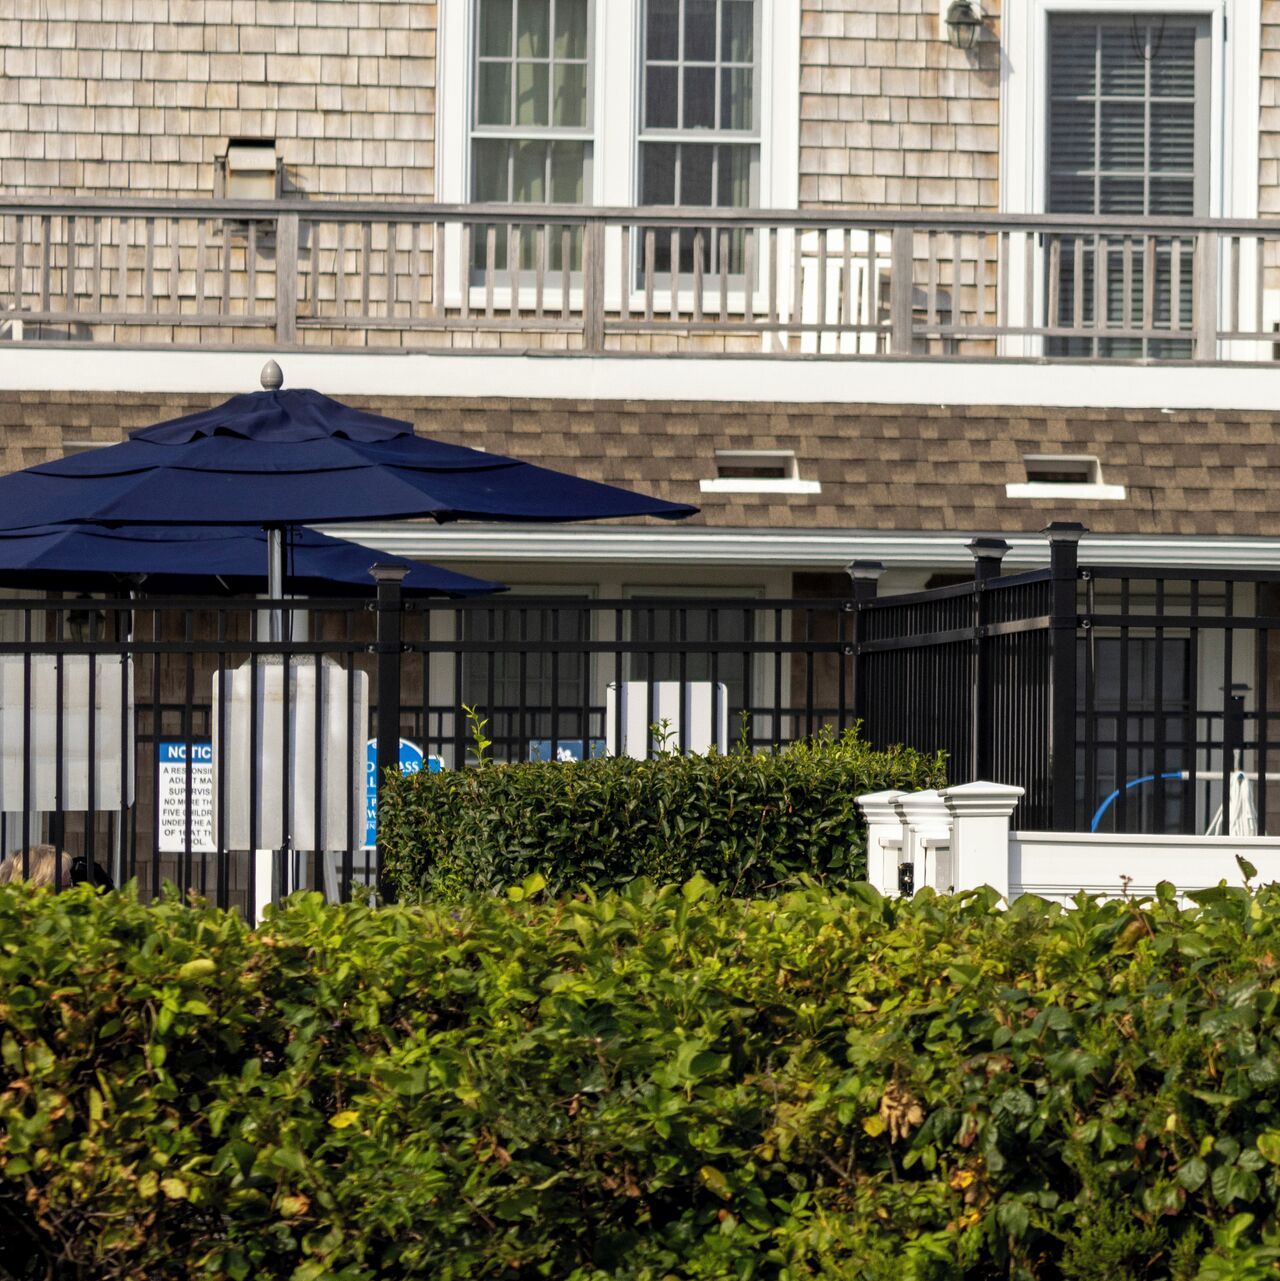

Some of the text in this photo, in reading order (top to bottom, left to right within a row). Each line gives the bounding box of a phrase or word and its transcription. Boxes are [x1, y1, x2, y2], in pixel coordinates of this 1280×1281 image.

[168, 745, 212, 759] NOTIC
[163, 767, 213, 775] A RESONSI
[169, 777, 197, 785] ADUT
[169, 787, 211, 796] SUPRVIS
[164, 798, 176, 806] NO
[178, 798, 200, 806] MRE
[163, 808, 181, 817] FIVE
[164, 829, 176, 837] OF
